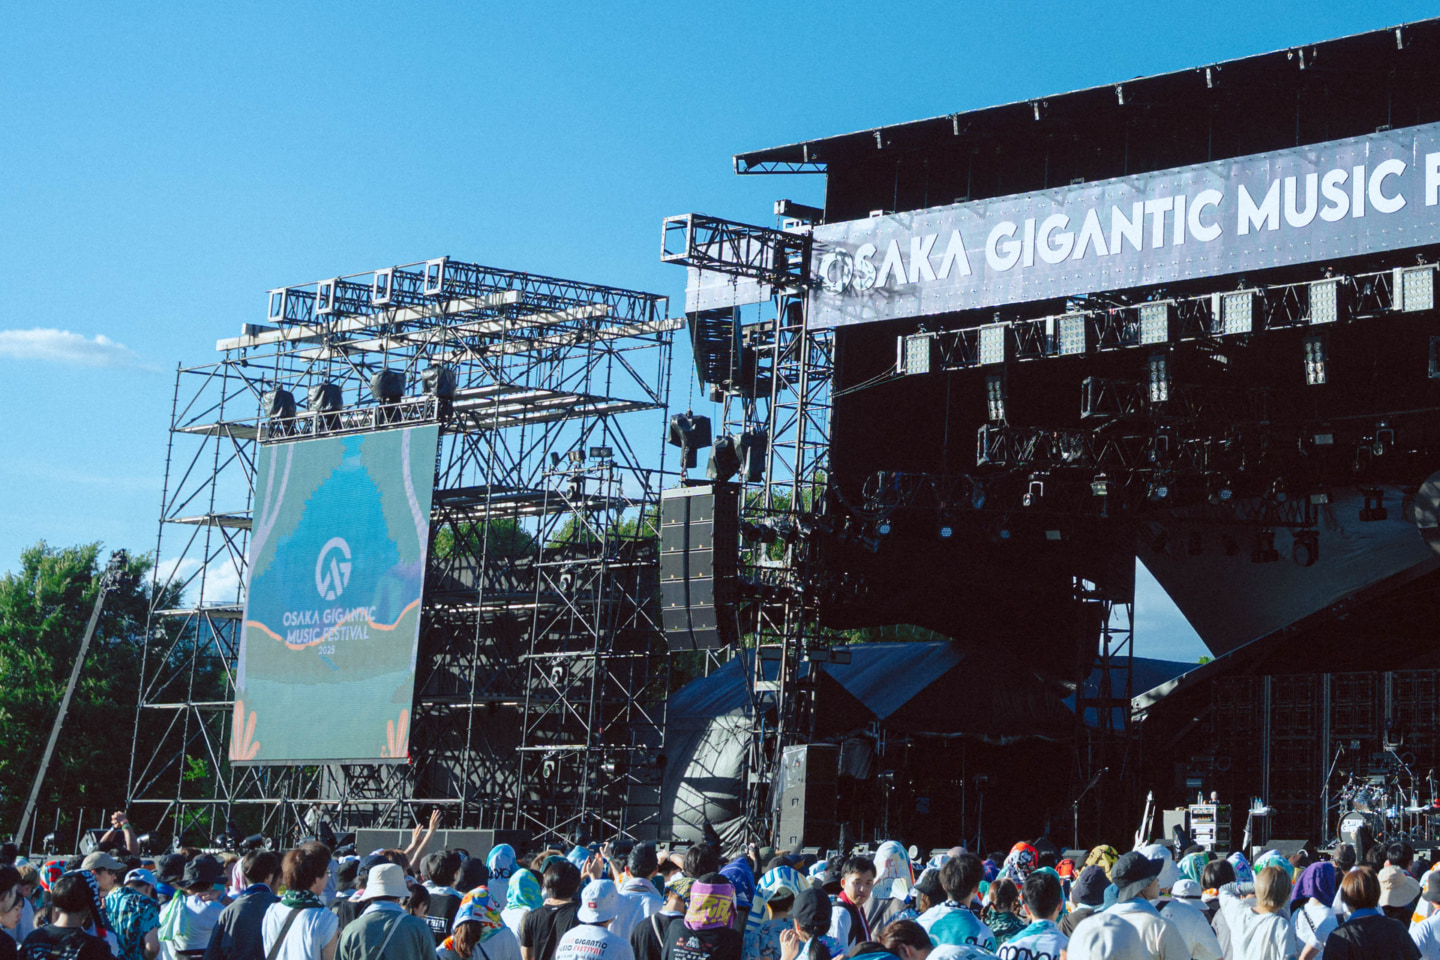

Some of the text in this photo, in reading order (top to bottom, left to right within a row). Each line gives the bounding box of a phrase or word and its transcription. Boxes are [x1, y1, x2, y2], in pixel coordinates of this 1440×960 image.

[819, 229, 972, 296] OSAKA
[985, 189, 1224, 272] GIGANTIC
[1237, 158, 1407, 235] MUSIC
[282, 606, 376, 626] OSAKA GIGANTIC
[286, 625, 369, 644] MUSIC FESTIVAL
[318, 645, 335, 655] 2025
